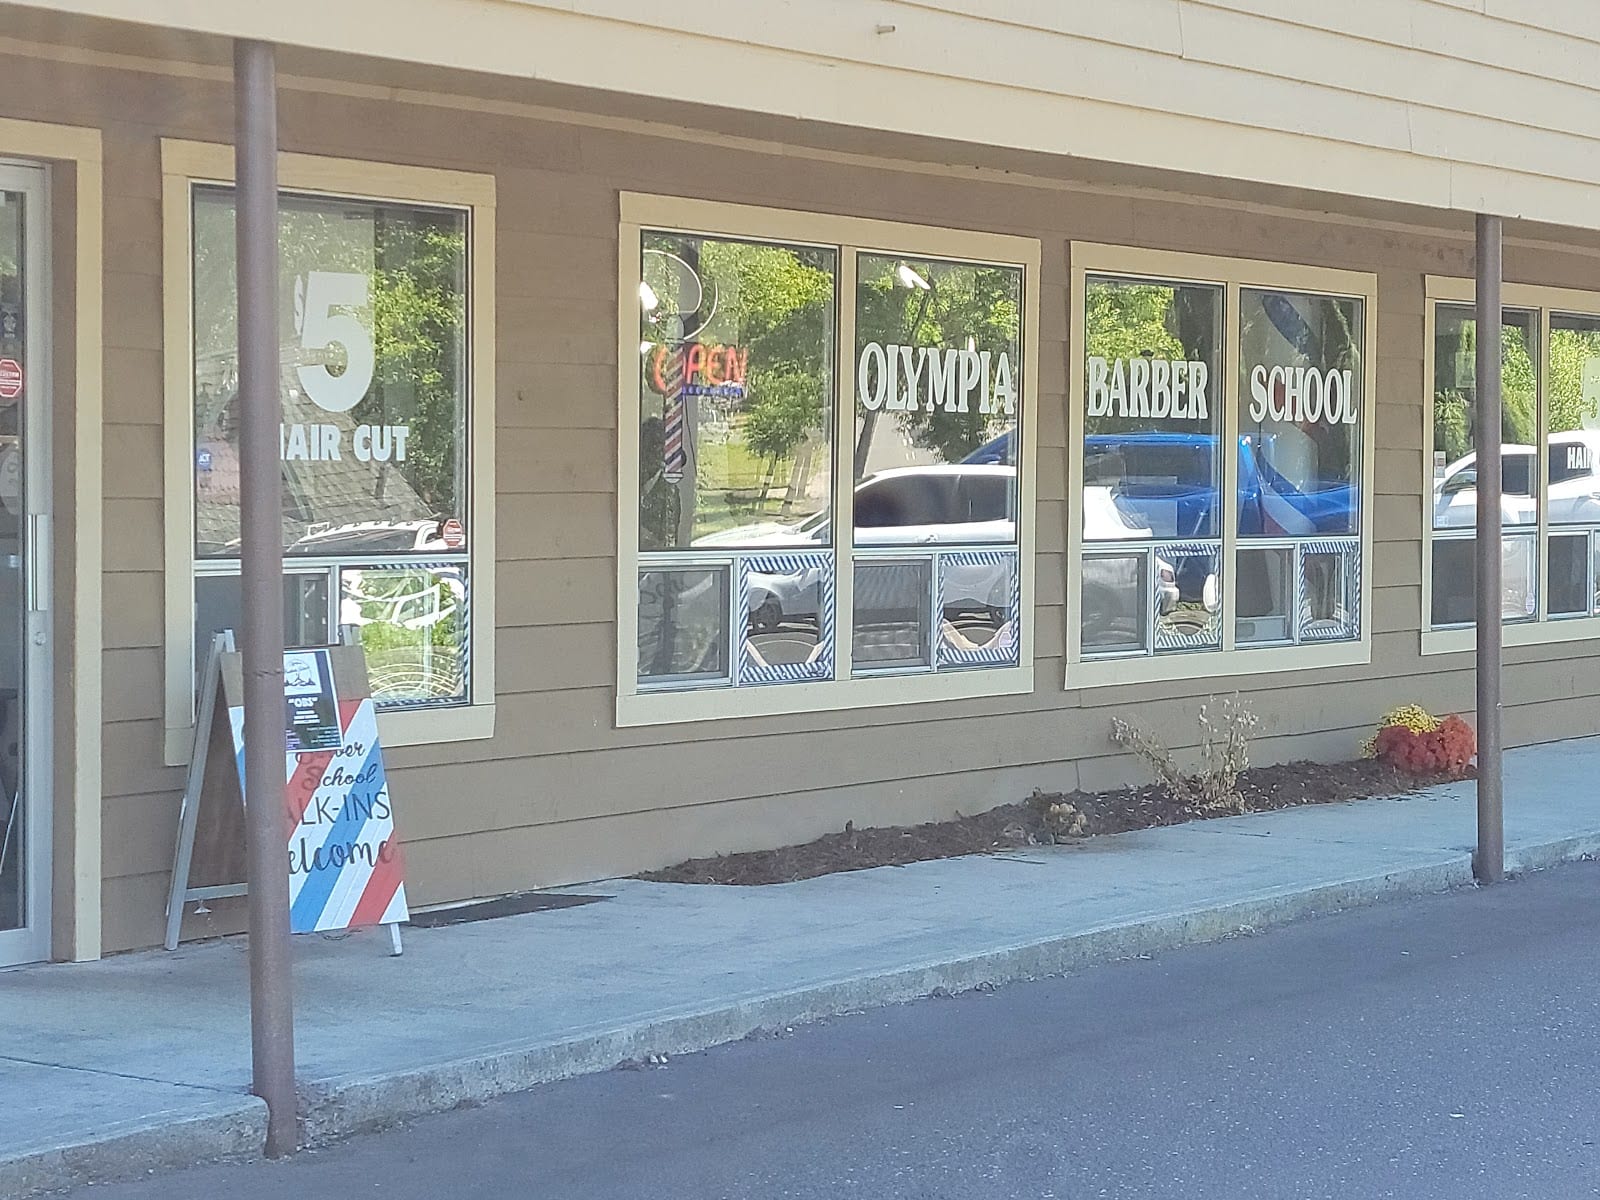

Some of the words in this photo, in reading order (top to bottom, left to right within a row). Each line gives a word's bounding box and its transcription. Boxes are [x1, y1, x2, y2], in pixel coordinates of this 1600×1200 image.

[858, 341, 1015, 415] OLYMPIA
[1087, 356, 1209, 419] BARBER
[1250, 364, 1357, 425] SCHOOL
[353, 423, 409, 462] CUT
[301, 762, 378, 791] School
[287, 837, 403, 875] elcome
